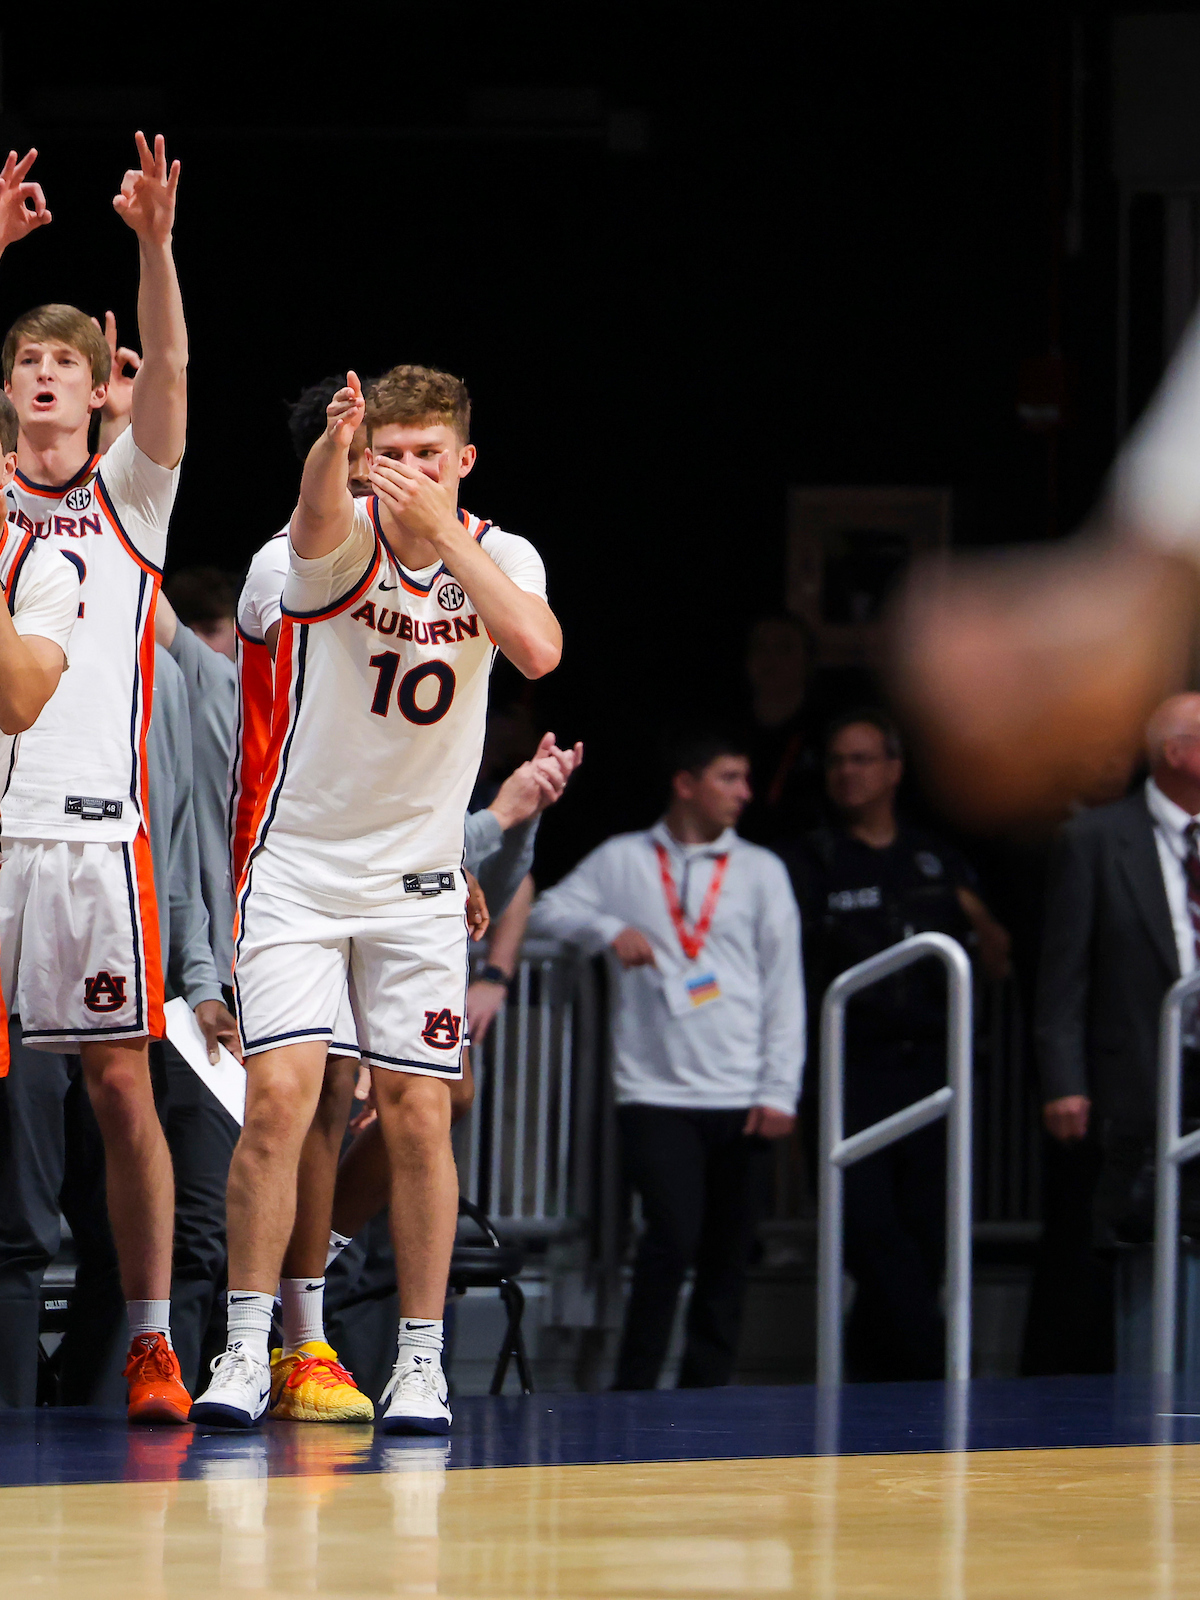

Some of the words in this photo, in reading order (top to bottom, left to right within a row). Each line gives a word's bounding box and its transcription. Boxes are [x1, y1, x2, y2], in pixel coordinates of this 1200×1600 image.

[67, 488, 90, 511] SEC
[8, 509, 103, 540] BURN
[439, 584, 464, 610] SEC
[351, 600, 480, 645] AUBURN
[369, 650, 456, 726] 10
